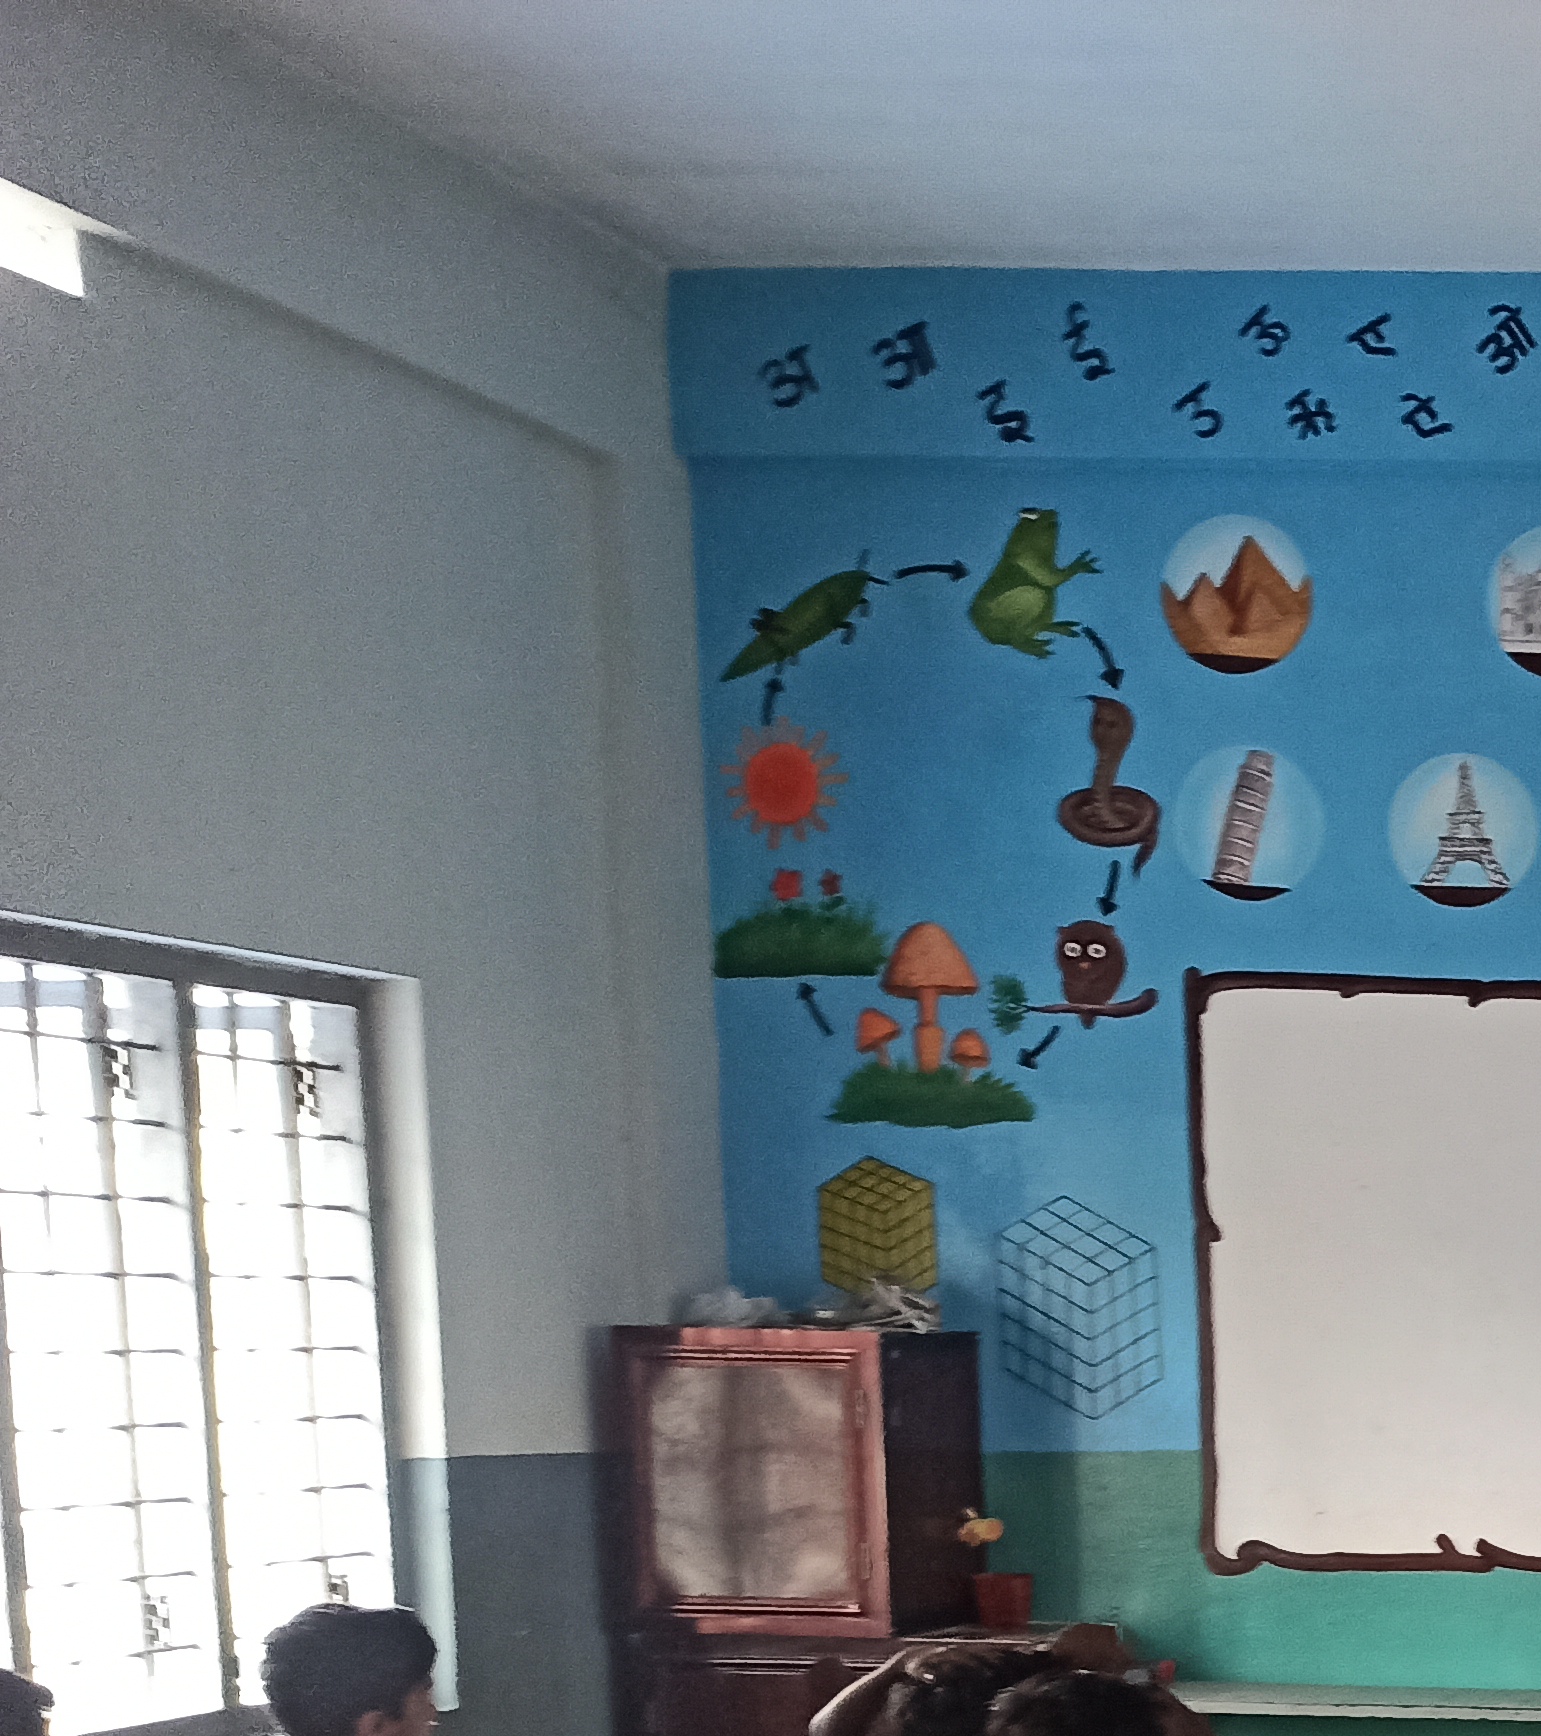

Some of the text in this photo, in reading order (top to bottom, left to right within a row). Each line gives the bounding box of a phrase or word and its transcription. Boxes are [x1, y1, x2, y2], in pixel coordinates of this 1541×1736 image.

[758, 343, 820, 409] अ
[976, 379, 1035, 444] इ
[1062, 301, 1116, 382] ई
[1172, 381, 1224, 439] उ
[1345, 312, 1398, 357] ए
[1400, 392, 1454, 439] ऐ
[1475, 303, 1538, 376] ओ
